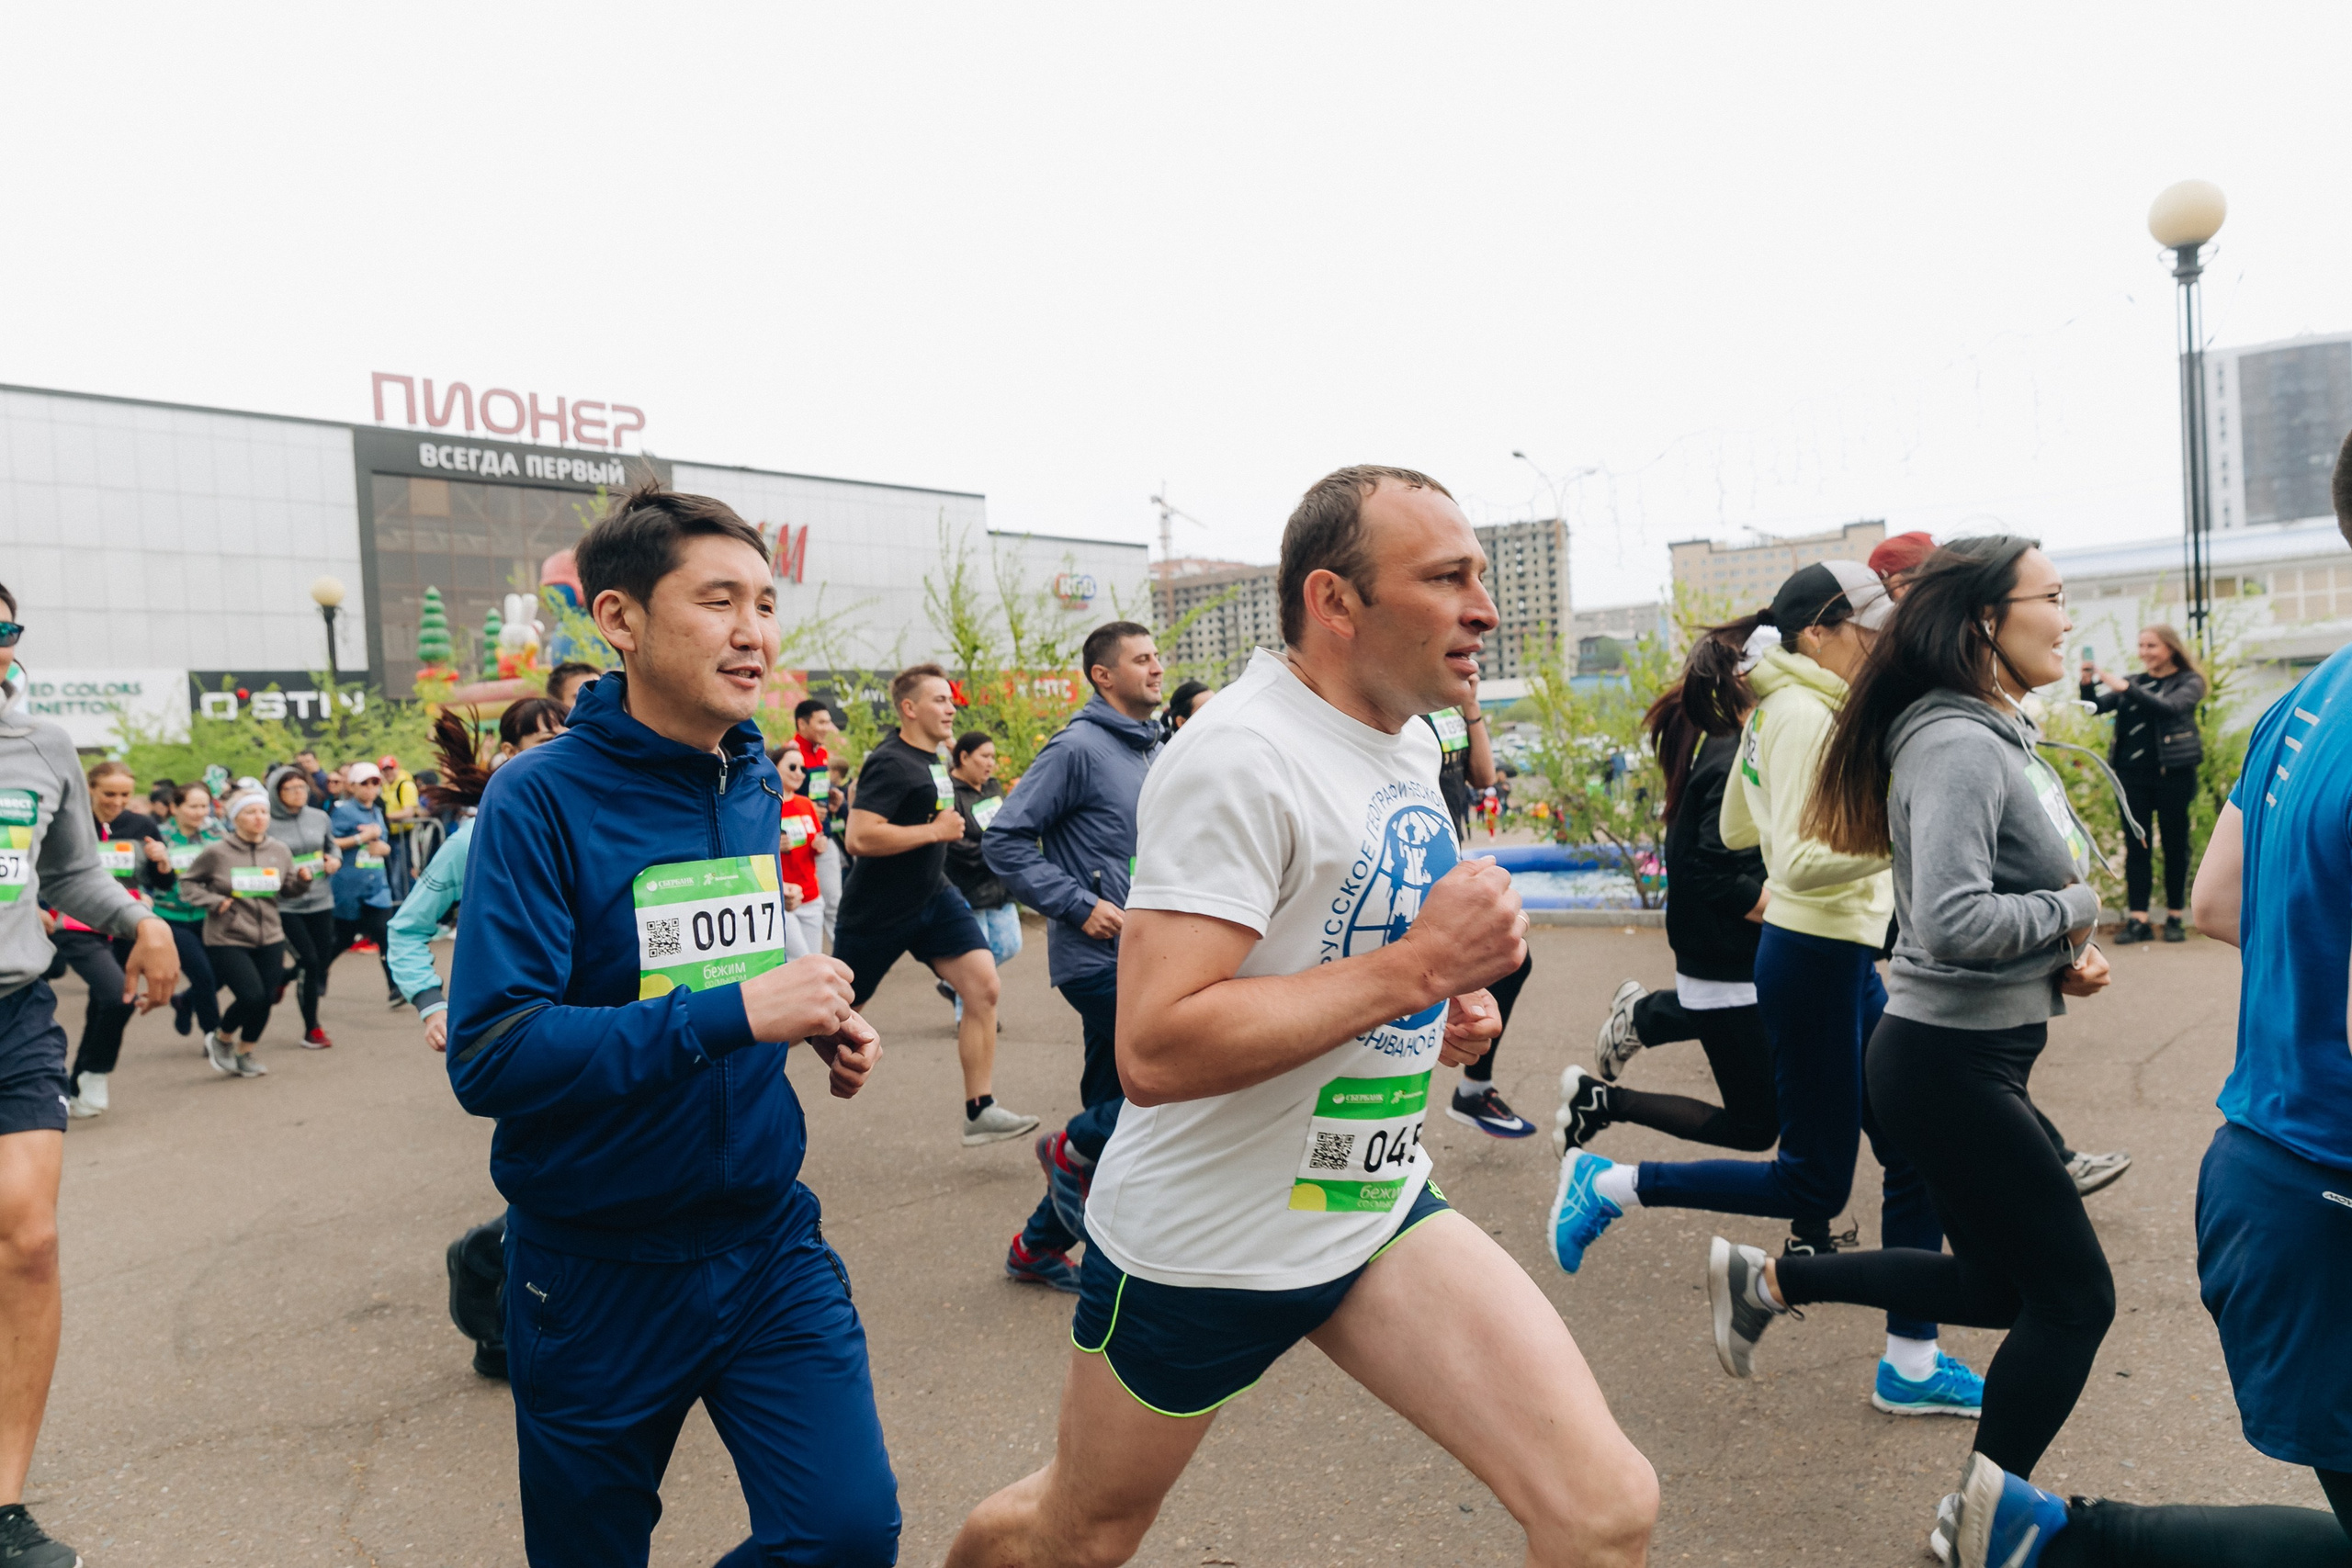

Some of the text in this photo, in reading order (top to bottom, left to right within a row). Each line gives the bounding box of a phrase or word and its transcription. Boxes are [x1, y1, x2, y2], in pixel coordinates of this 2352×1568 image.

[371, 371, 645, 447] ПИОНЕР
[418, 442, 626, 486] ВСЕГДА ПЕРВЫЙ
[61, 681, 141, 696] COLORS
[693, 902, 775, 951] 0017
[703, 962, 746, 979] бежим
[1360, 1184, 1402, 1200] бежи
